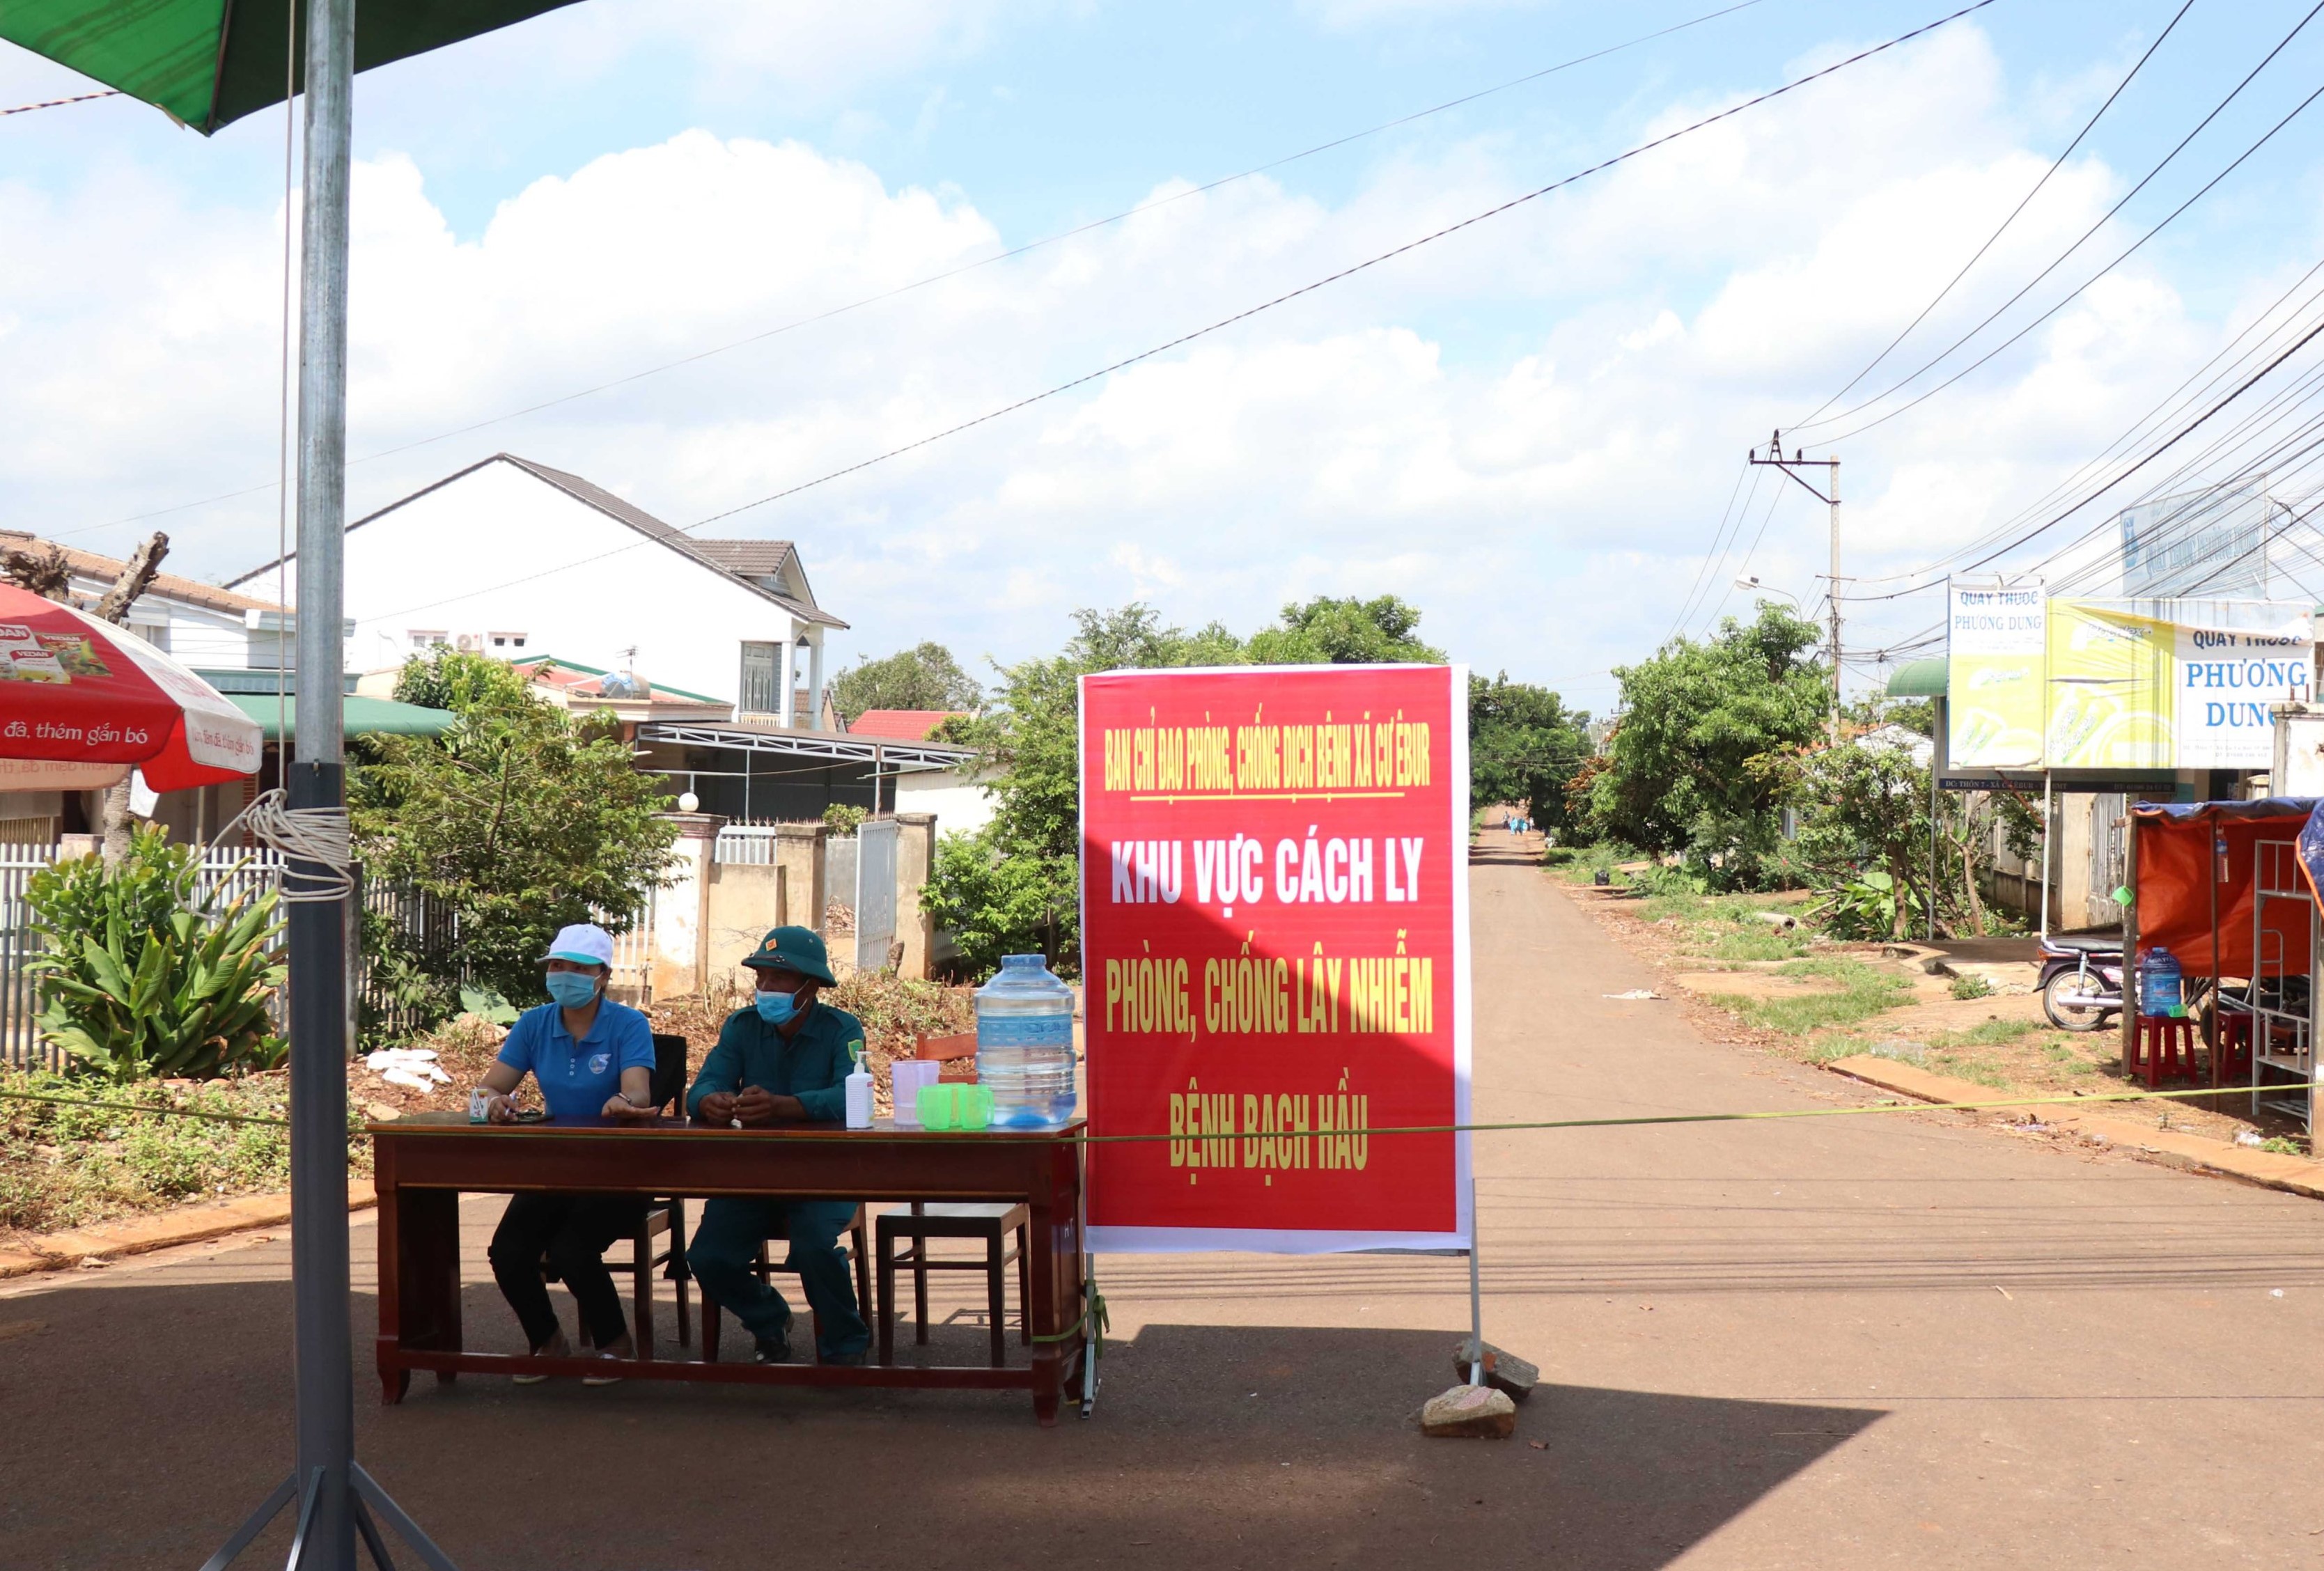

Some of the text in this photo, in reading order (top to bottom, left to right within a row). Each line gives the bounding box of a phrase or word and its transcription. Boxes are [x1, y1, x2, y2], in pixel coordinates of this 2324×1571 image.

[2009, 616, 2043, 630] DUNG
[2186, 657, 2307, 688] PHƯƠNG
[36, 721, 82, 740] thêm
[86, 722, 120, 746] gắn
[125, 727, 148, 744] bó
[1105, 703, 1430, 804] BAN CHỈ ĐẠO PHÒNG, CHỐNG DỊCH BỆNH XÃ CƯ ÊBUR
[1959, 779, 1979, 788] THÔN
[1112, 824, 1424, 918] KHU VỰC CÁCH LY
[1105, 928, 1433, 1042] PHÒNG, CHỐNG LÂY NHIỄM
[1169, 1066, 1368, 1187] BỆNH BẠCH HẦU
